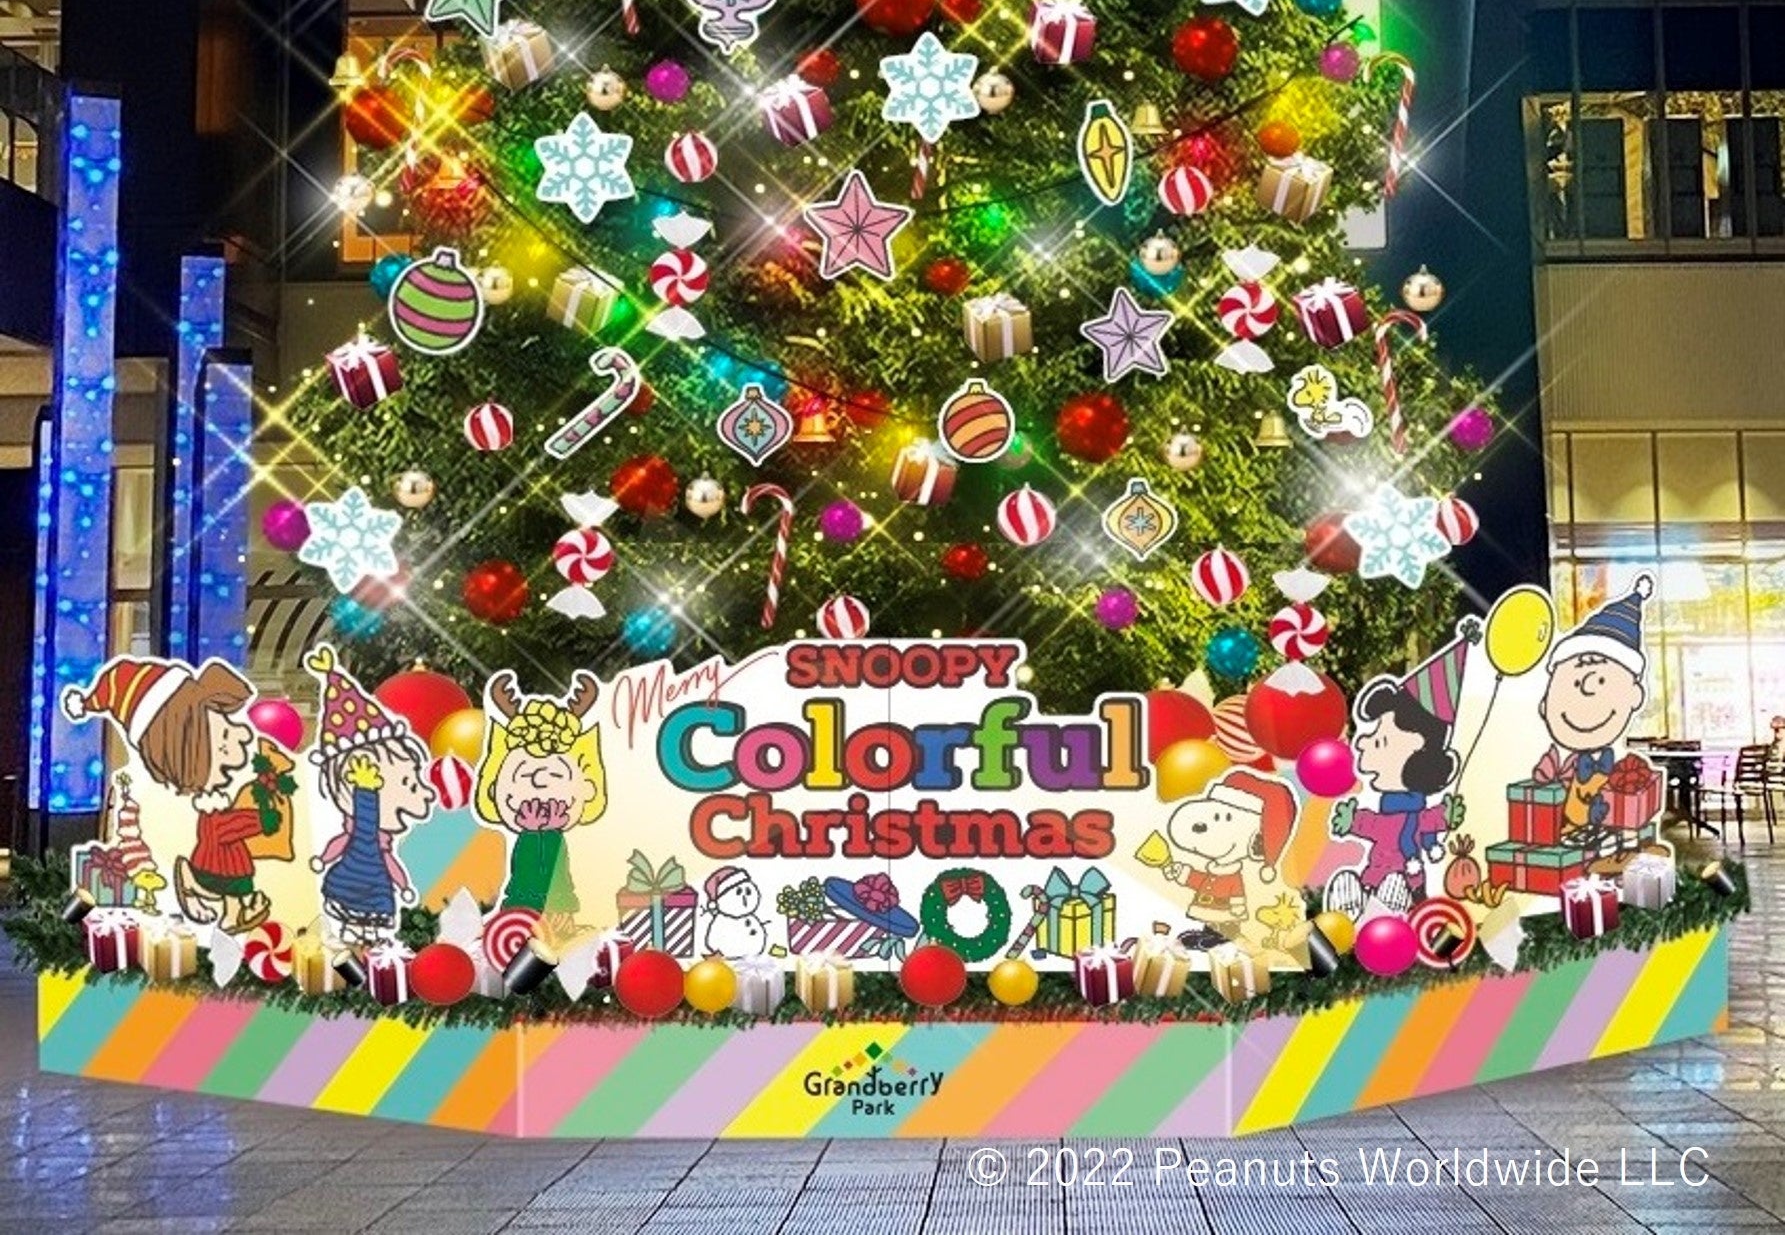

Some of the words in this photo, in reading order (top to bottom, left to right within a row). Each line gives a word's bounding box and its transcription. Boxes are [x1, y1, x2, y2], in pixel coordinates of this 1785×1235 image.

[786, 643, 1019, 689] SNOOPY
[612, 651, 779, 749] Merry
[656, 697, 1150, 793] Colorful
[689, 792, 1116, 860] Christmas
[803, 1065, 944, 1097] Grandberry
[851, 1099, 896, 1116] Park
